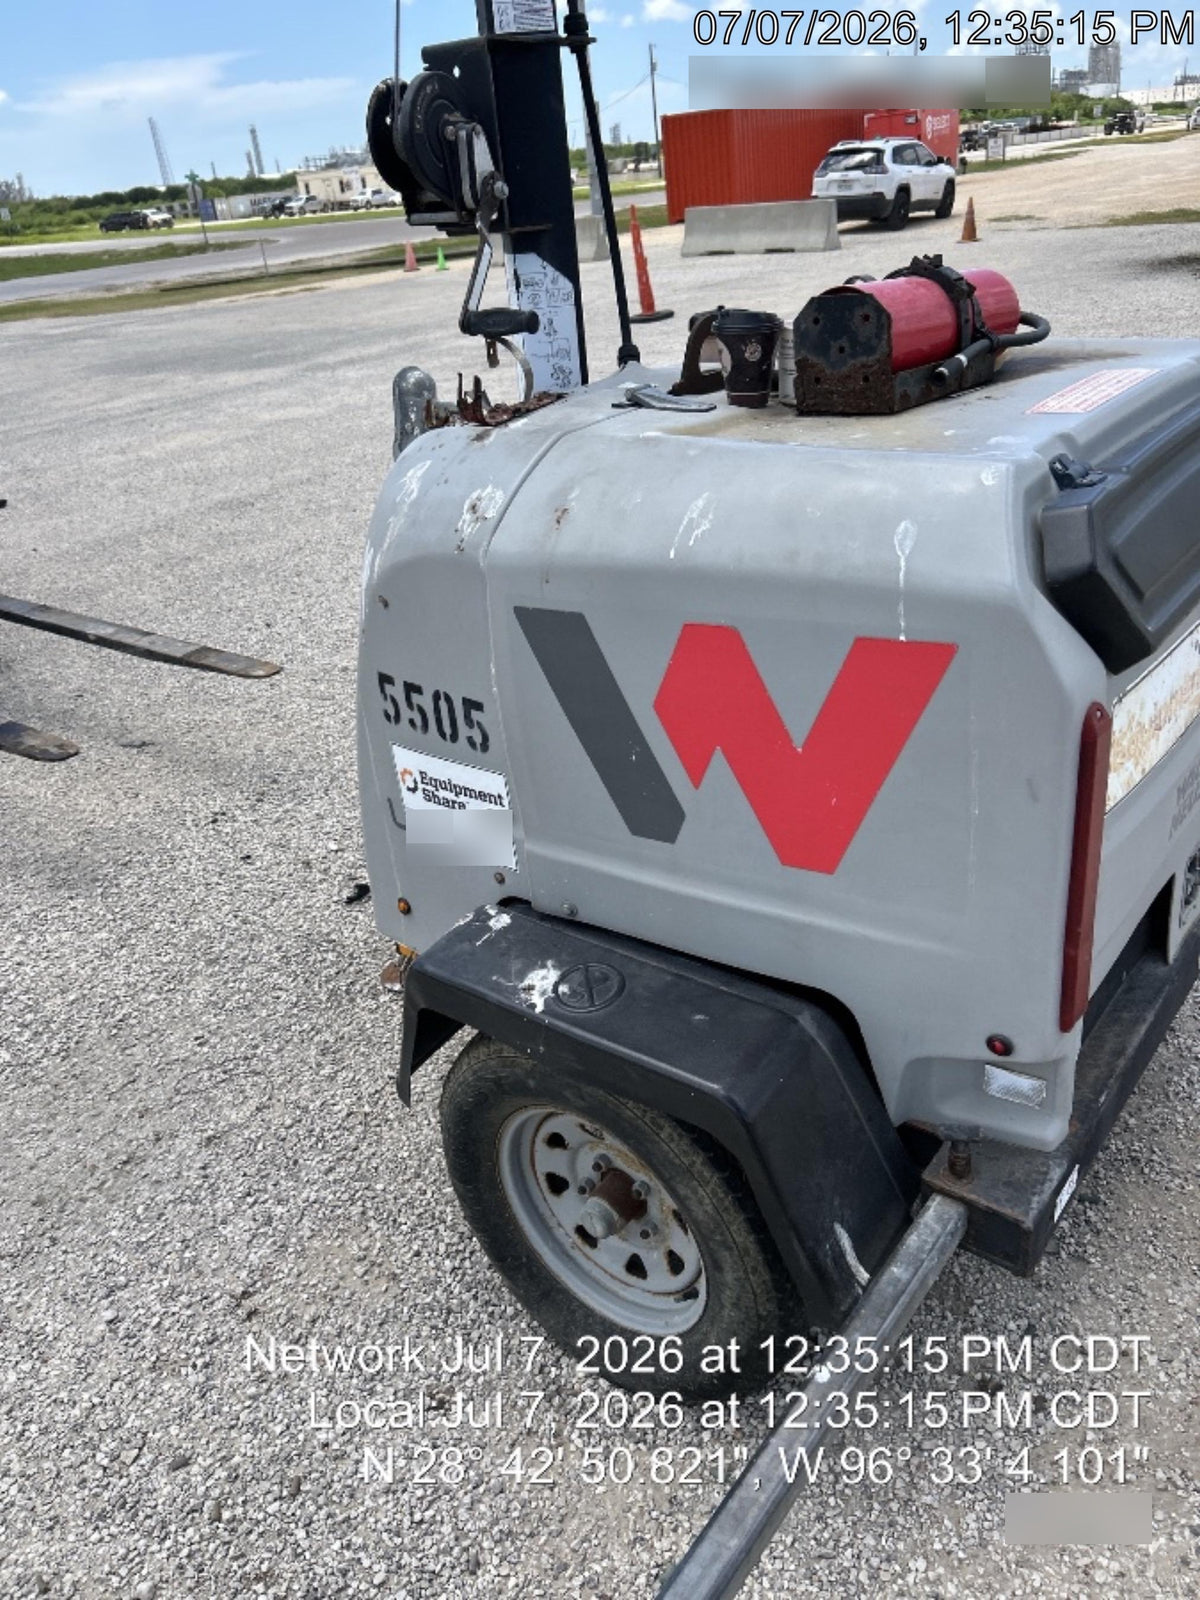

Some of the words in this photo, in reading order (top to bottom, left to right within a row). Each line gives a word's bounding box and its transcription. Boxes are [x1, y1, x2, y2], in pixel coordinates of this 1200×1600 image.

[378, 671, 490, 753] 5505
[419, 771, 505, 807] Equipment
[422, 788, 466, 809] Share
